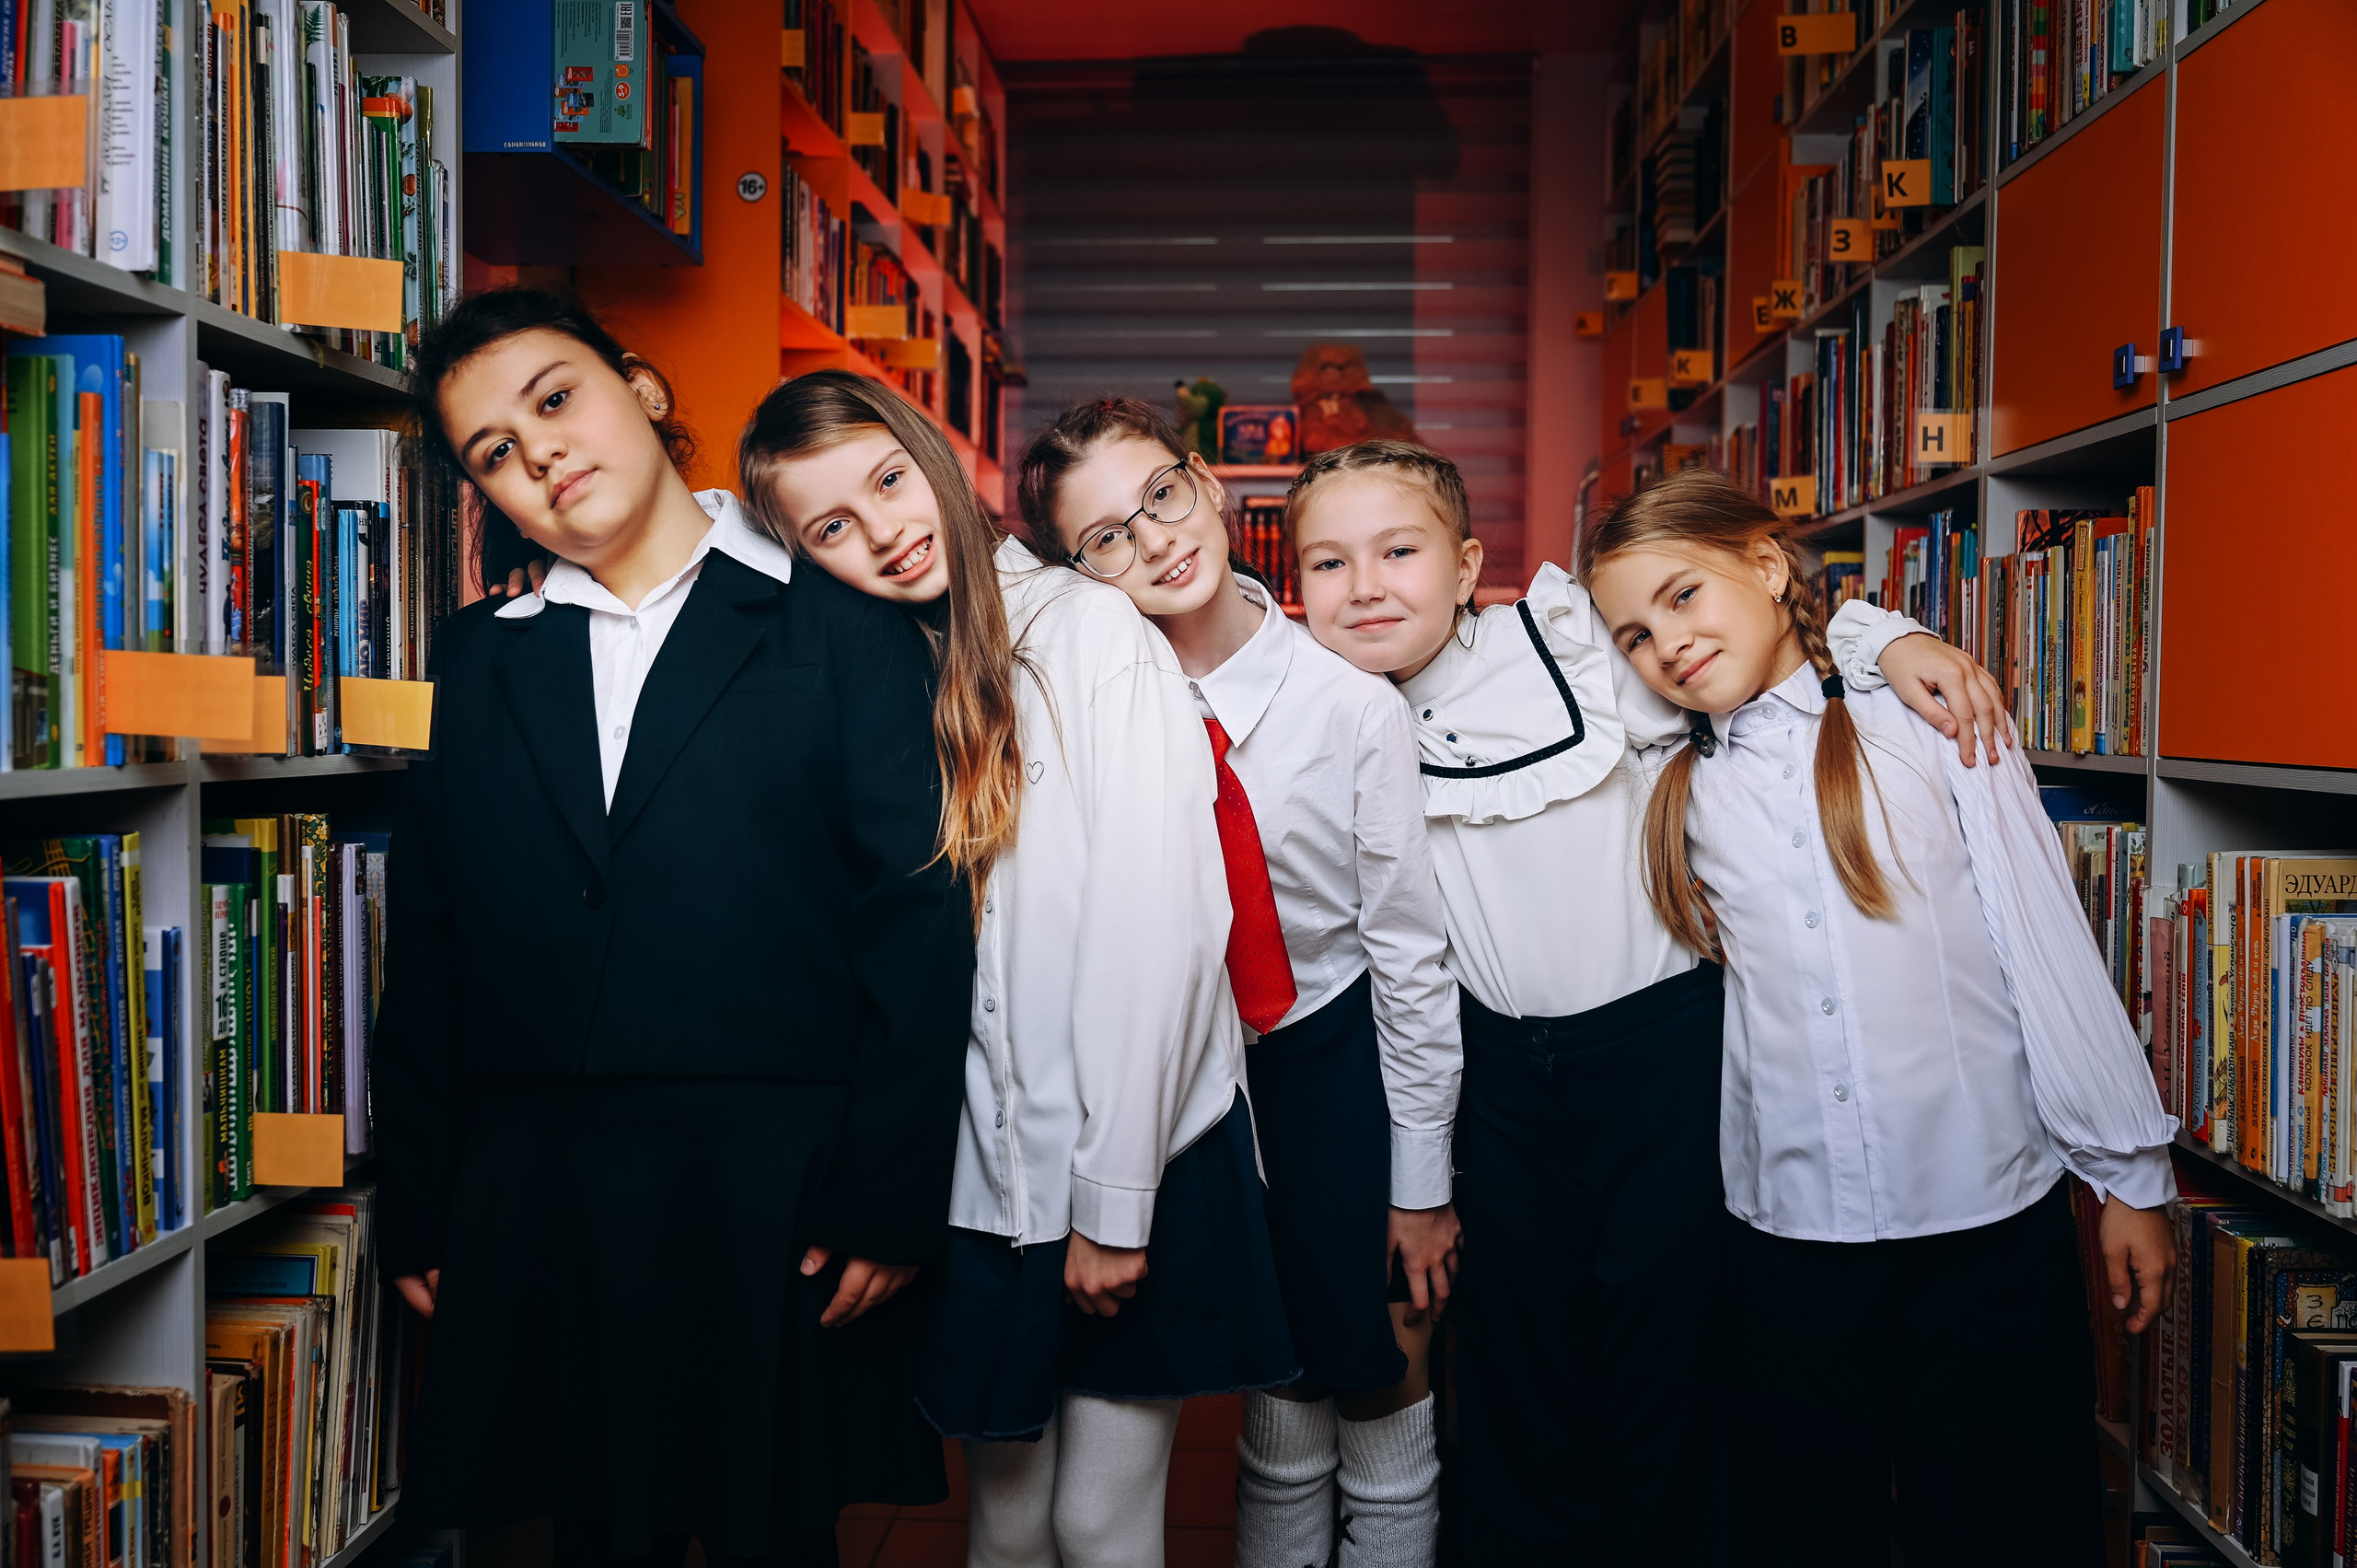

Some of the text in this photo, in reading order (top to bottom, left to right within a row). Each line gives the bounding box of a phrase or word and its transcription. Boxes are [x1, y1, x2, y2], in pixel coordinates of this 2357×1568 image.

[1781, 26, 1796, 47] В
[160, 76, 171, 242] ДОМАШНИЕ КОШКИ
[740, 180, 764, 195] 16+
[1887, 172, 1907, 197] К
[1833, 229, 1850, 252] З
[1757, 305, 1768, 325] Е
[1774, 289, 1796, 310] Ж
[1922, 425, 1944, 452] Н
[1775, 487, 1797, 508] М
[49, 536, 59, 593] БИЗНЕС
[198, 503, 208, 596] ЧУДЕСА
[49, 598, 58, 609] И
[302, 559, 314, 691] Чудеса света
[359, 598, 370, 643] МИР
[49, 615, 60, 676] ДЕНЬГИ
[2123, 730, 2129, 741] С.
[115, 920, 123, 964] ВСЕМ
[219, 932, 228, 978] старше
[269, 946, 278, 1041] МИФОЛОГИЧЕСКИЙ
[2306, 995, 2313, 1011] ПО
[2249, 1018, 2259, 1043] Дядя
[2297, 1036, 2305, 1096] КАНИКУЛЫ
[2305, 1043, 2313, 1092] КОЛОБОК
[2328, 973, 2340, 1174] МЕХОВОЙ ИНТЕРНАТ
[218, 1049, 229, 1144] МАЛЬЧИШКАМ
[2304, 1106, 2312, 1149] Успенский
[140, 1106, 151, 1205] МАЛЬЧИКОВ
[2295, 1124, 2305, 1182] Э.Успенский
[2305, 1151, 2311, 1161] Э.
[2174, 1237, 2191, 1470] ЗОЛОТЫЕ СКАЗКИ
[2159, 1331, 2174, 1459] ЗОЛОТЫЕ
[2235, 1376, 2247, 1511] Сказки доброты
